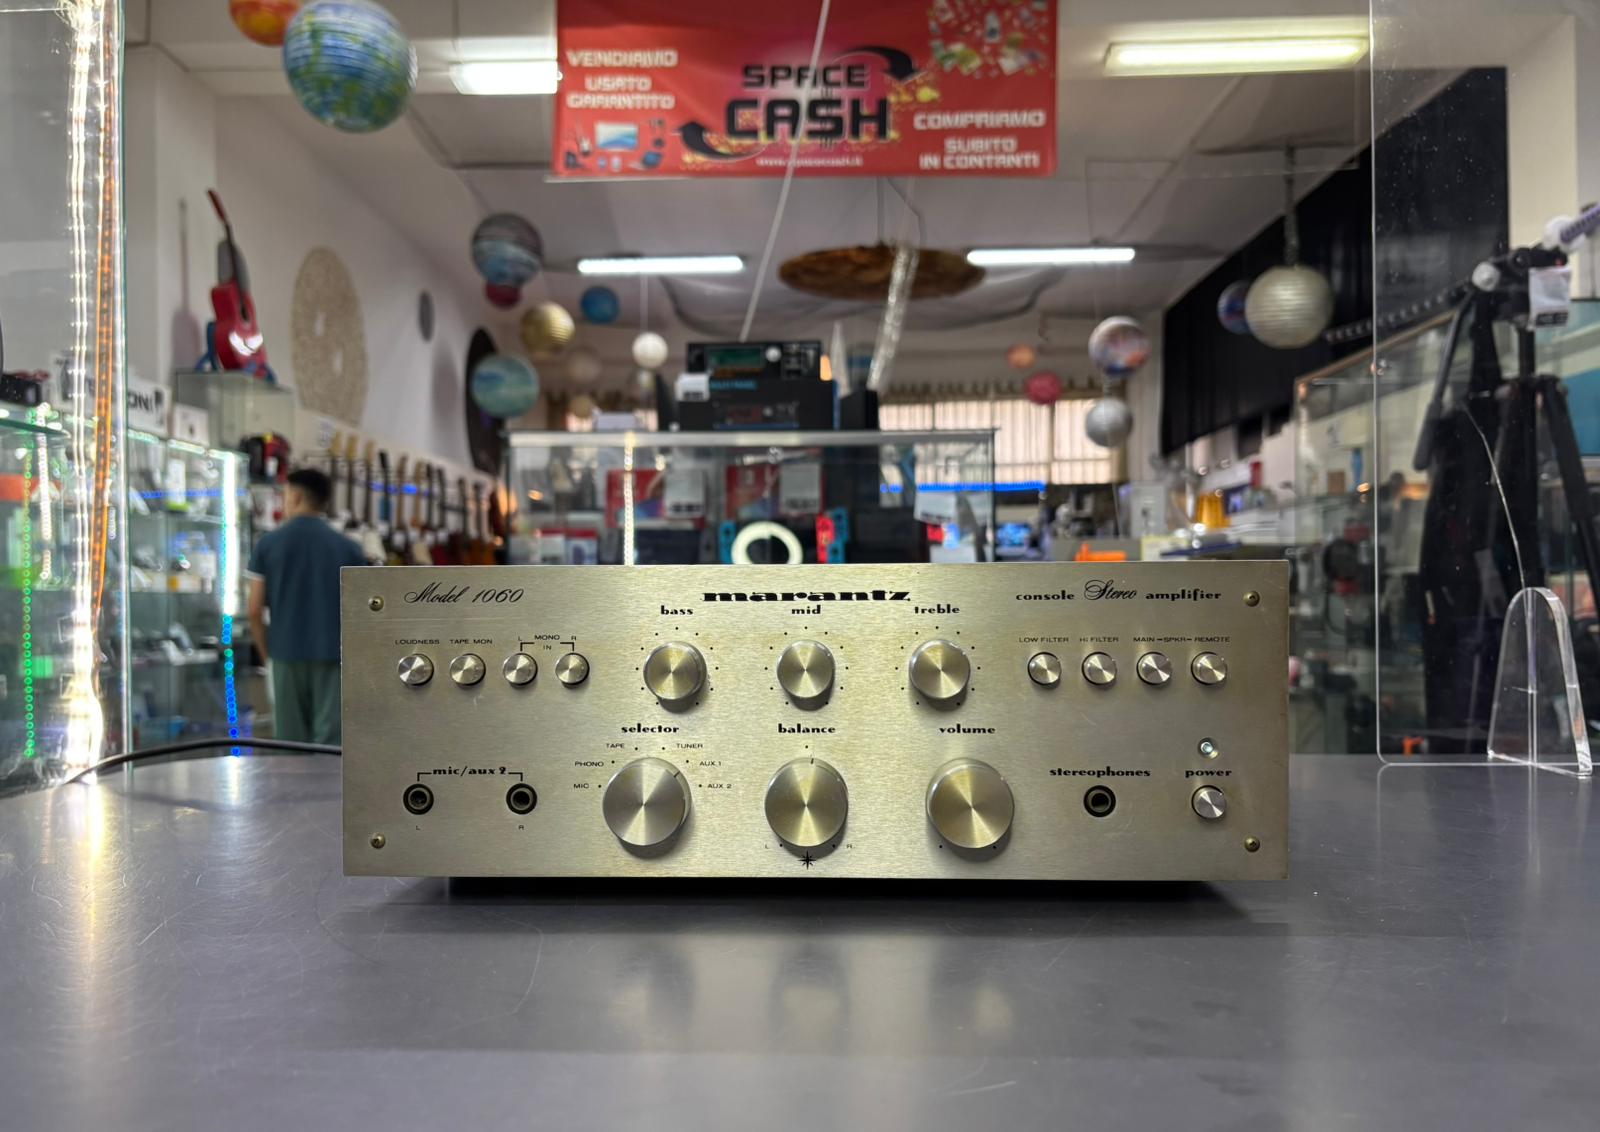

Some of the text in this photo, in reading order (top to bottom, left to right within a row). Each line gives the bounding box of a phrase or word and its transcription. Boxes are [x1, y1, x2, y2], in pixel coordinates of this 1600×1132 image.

[566, 49, 678, 67] VENDIAMO
[743, 64, 866, 88] SPACE
[584, 76, 652, 92] USATO
[566, 93, 675, 109] GARANTITO
[726, 98, 889, 140] CASH
[913, 110, 1046, 130] COMPRIAMO
[944, 137, 1018, 153] SUBITO
[919, 152, 1040, 169] IN CONTANTI
[403, 582, 524, 604] Model 1060
[702, 590, 910, 602] marantz
[1015, 579, 1222, 602] console Stereo amplifier
[660, 605, 693, 615] bass
[791, 605, 821, 615] mid
[914, 604, 960, 615] treble
[621, 723, 679, 733] selector
[778, 723, 836, 734] balance
[939, 723, 996, 734] volume
[432, 766, 496, 777] mic/aux
[1050, 766, 1151, 778] stereophones
[1185, 769, 1232, 778] power
